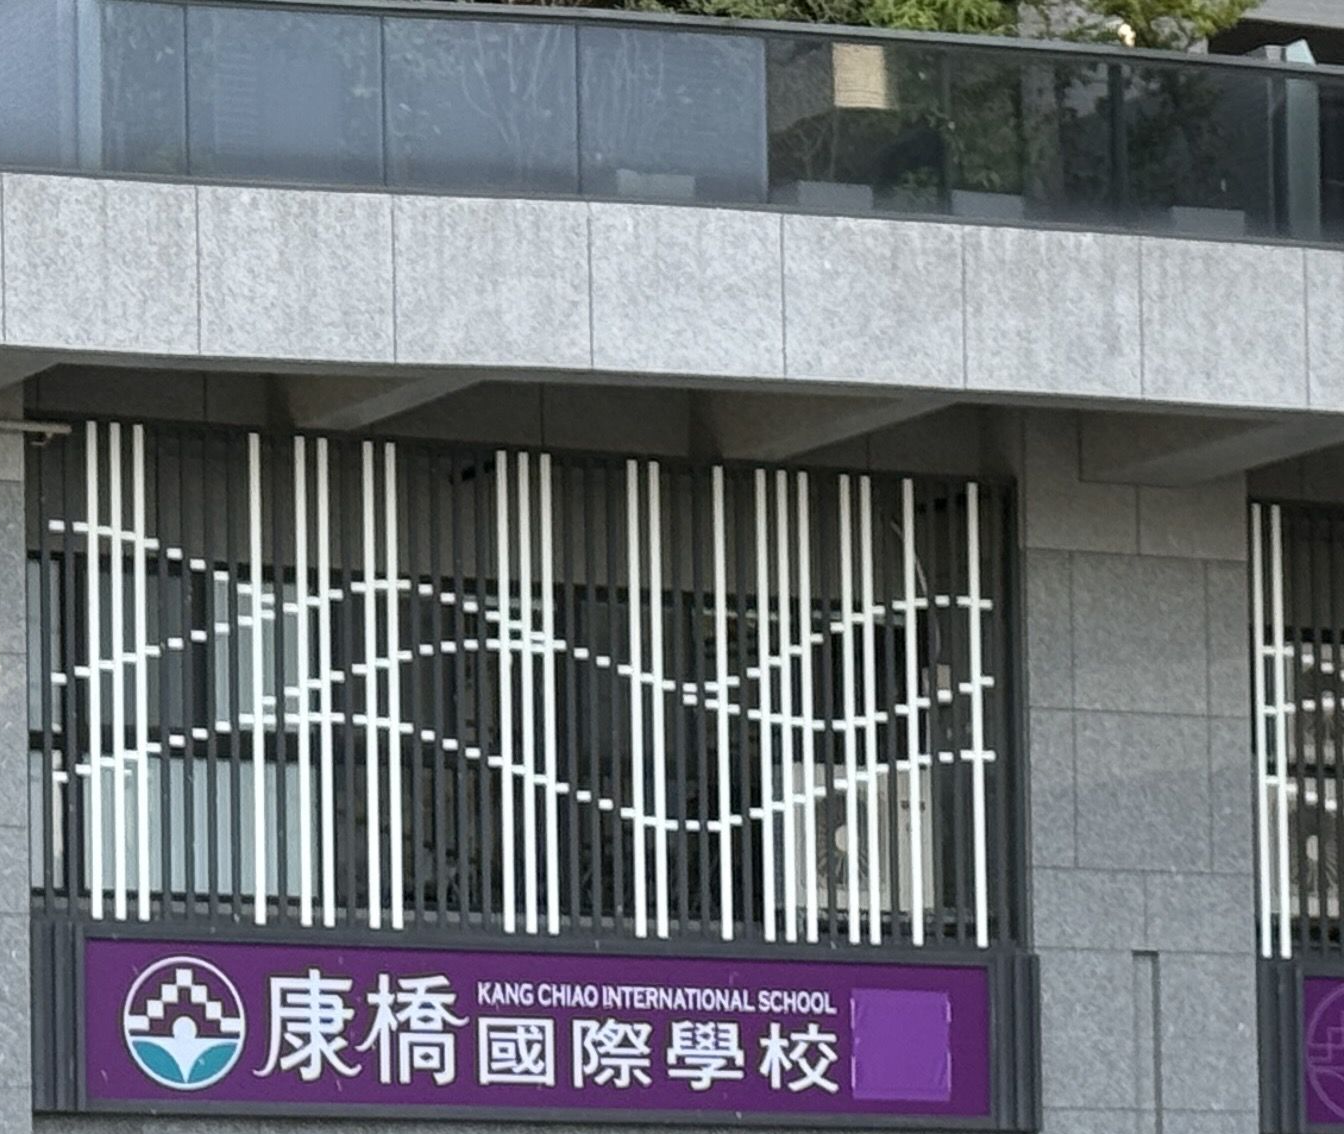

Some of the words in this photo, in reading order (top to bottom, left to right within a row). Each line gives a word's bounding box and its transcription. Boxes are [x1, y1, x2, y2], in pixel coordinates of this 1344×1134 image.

[253, 968, 470, 1085] 康橋
[477, 982, 538, 1007] KANG
[538, 984, 599, 1009] CHIAO
[603, 986, 755, 1013] INTERNATIONAL
[758, 990, 837, 1015] SCHOOL
[478, 1016, 840, 1093] 國際學校
